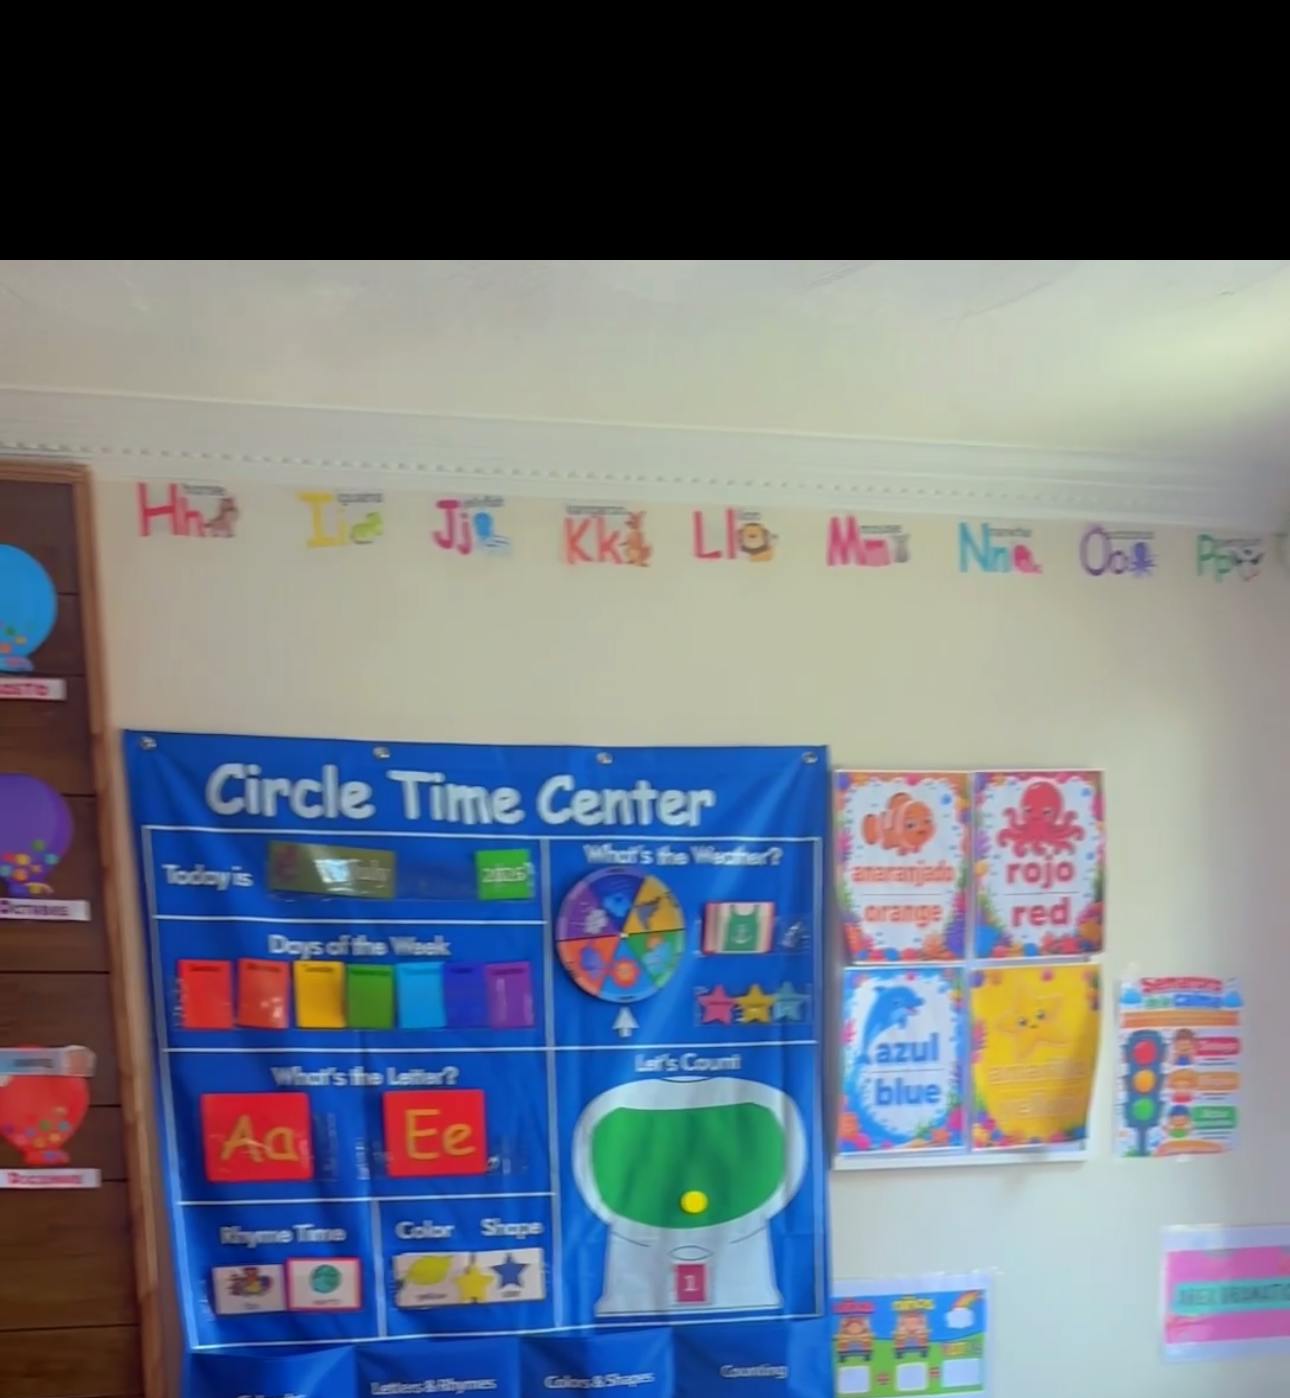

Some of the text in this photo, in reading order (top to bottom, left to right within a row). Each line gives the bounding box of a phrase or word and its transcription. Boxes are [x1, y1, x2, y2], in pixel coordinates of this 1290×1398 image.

[137, 482, 206, 537] Hh
[433, 498, 472, 555] Jj
[564, 516, 623, 565] Kk
[1080, 524, 1129, 576] Oo
[205, 762, 716, 828] Circle Time Center
[583, 843, 784, 866] What's the Weather?
[162, 864, 254, 890] Today is
[1006, 854, 1075, 890] rojo
[863, 904, 944, 929] orange
[1011, 896, 1072, 928] red
[268, 935, 451, 960] Days of the Week
[875, 1031, 940, 1063] azul
[271, 1065, 459, 1087] What's the Letter?
[635, 1053, 742, 1073] Let's Count
[874, 1078, 941, 1106] blue
[221, 1113, 300, 1163] Aa
[404, 1108, 477, 1161] Ee
[220, 1223, 347, 1248] Rhyme Time
[396, 1220, 455, 1240] Color
[480, 1218, 545, 1240] Shape
[544, 1375, 591, 1389] Colors
[605, 1372, 656, 1388] Shapes
[721, 1364, 789, 1380] Counting
[371, 1380, 425, 1396] Letters
[437, 1377, 498, 1395] Rhymes
